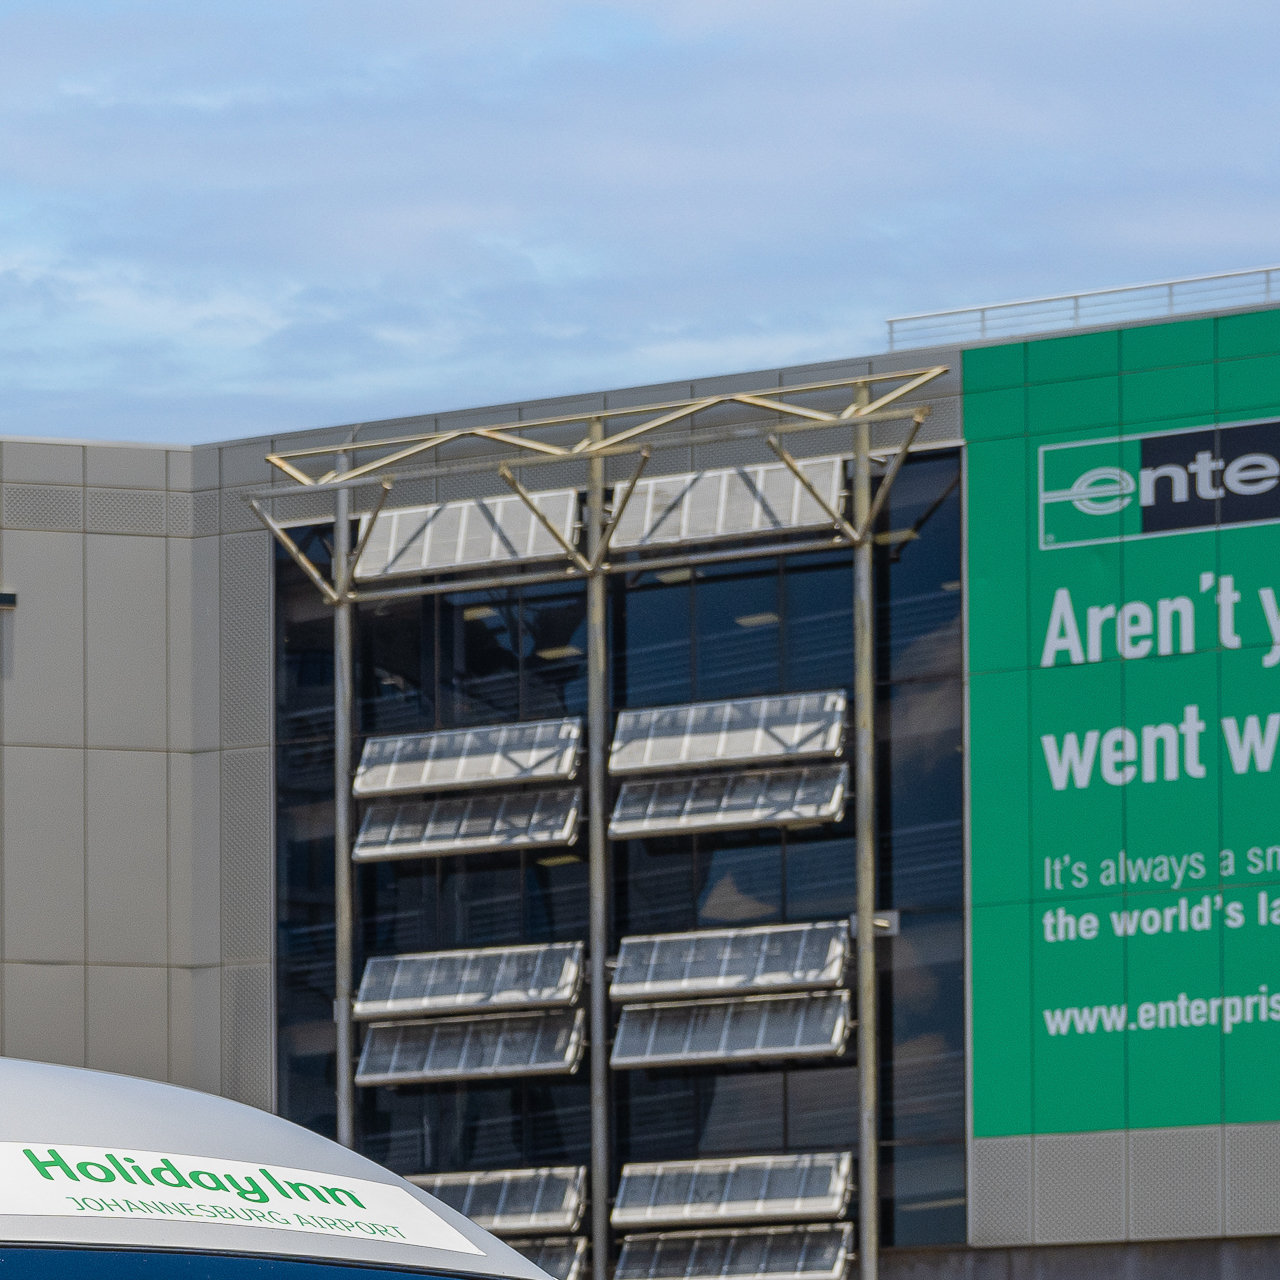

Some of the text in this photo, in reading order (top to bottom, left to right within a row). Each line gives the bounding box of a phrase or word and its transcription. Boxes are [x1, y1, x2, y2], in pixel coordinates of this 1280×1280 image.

[1040, 571, 1241, 668] Aren't
[1040, 704, 1206, 791] went
[1044, 854, 1089, 890] It's
[1099, 849, 1207, 890] always
[1219, 849, 1236, 877] a
[1042, 907, 1100, 943] the
[1109, 894, 1245, 938] world's
[22, 1148, 367, 1210] Holiday Inn
[65, 1196, 407, 1239] JOHANNESBURG AIRPORT
